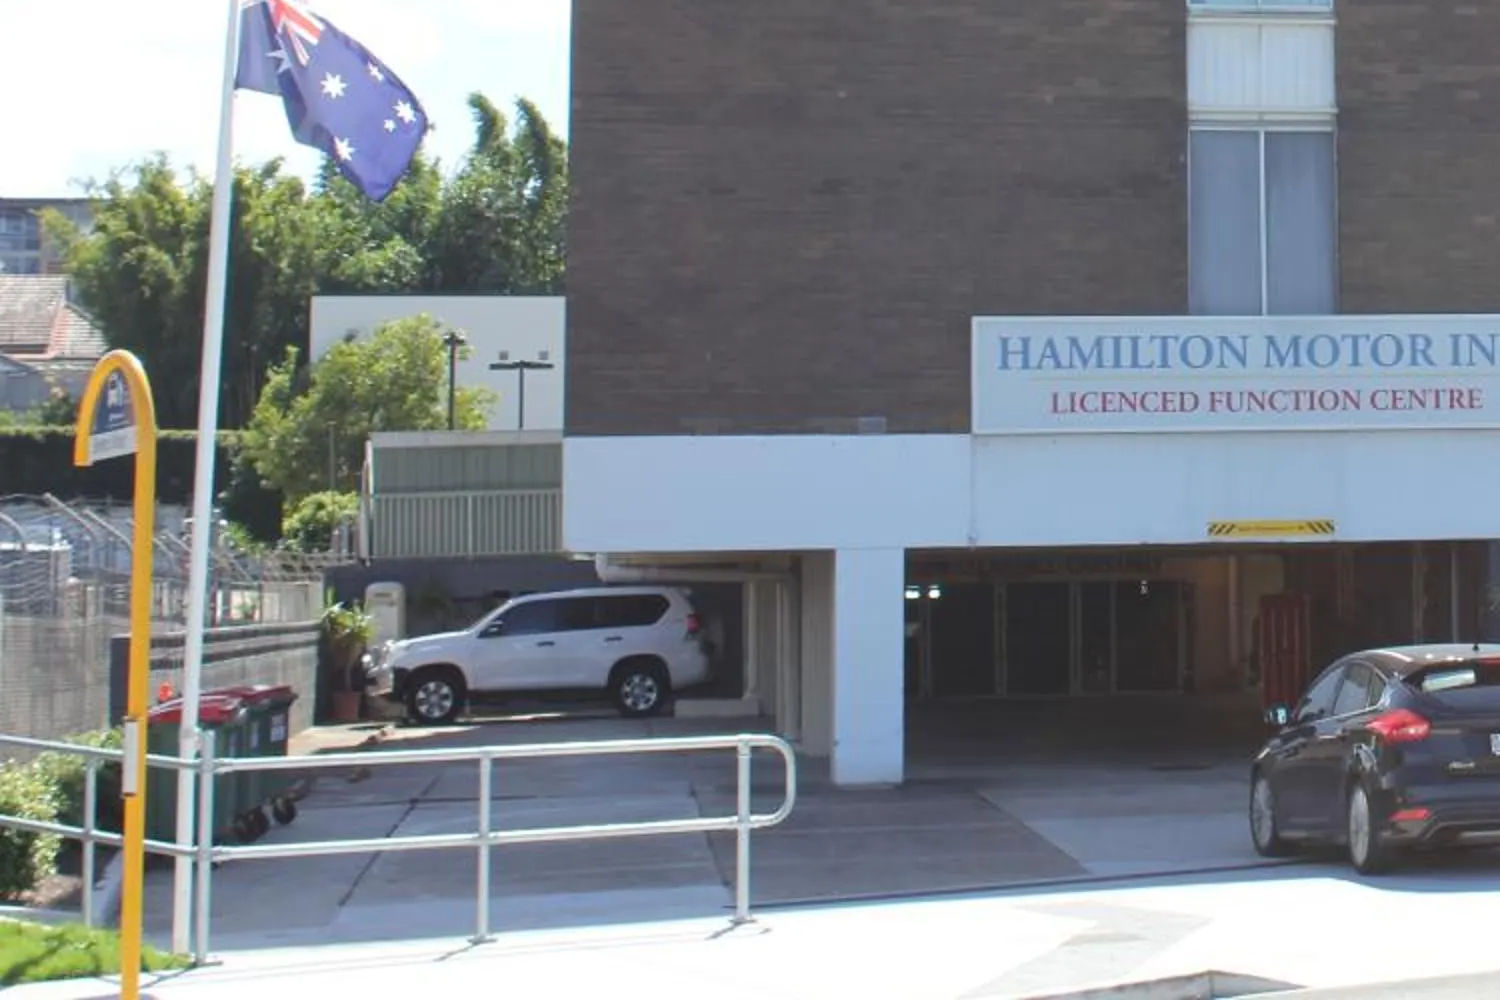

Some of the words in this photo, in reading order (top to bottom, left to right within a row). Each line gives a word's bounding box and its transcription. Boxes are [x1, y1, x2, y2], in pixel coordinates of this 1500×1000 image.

[998, 334, 1249, 371] HAMILTON
[1263, 333, 1437, 368] MOTOR
[1050, 391, 1200, 414] LICENCED
[1208, 389, 1361, 412] FUNCTION
[1369, 388, 1484, 411] CENTRE
